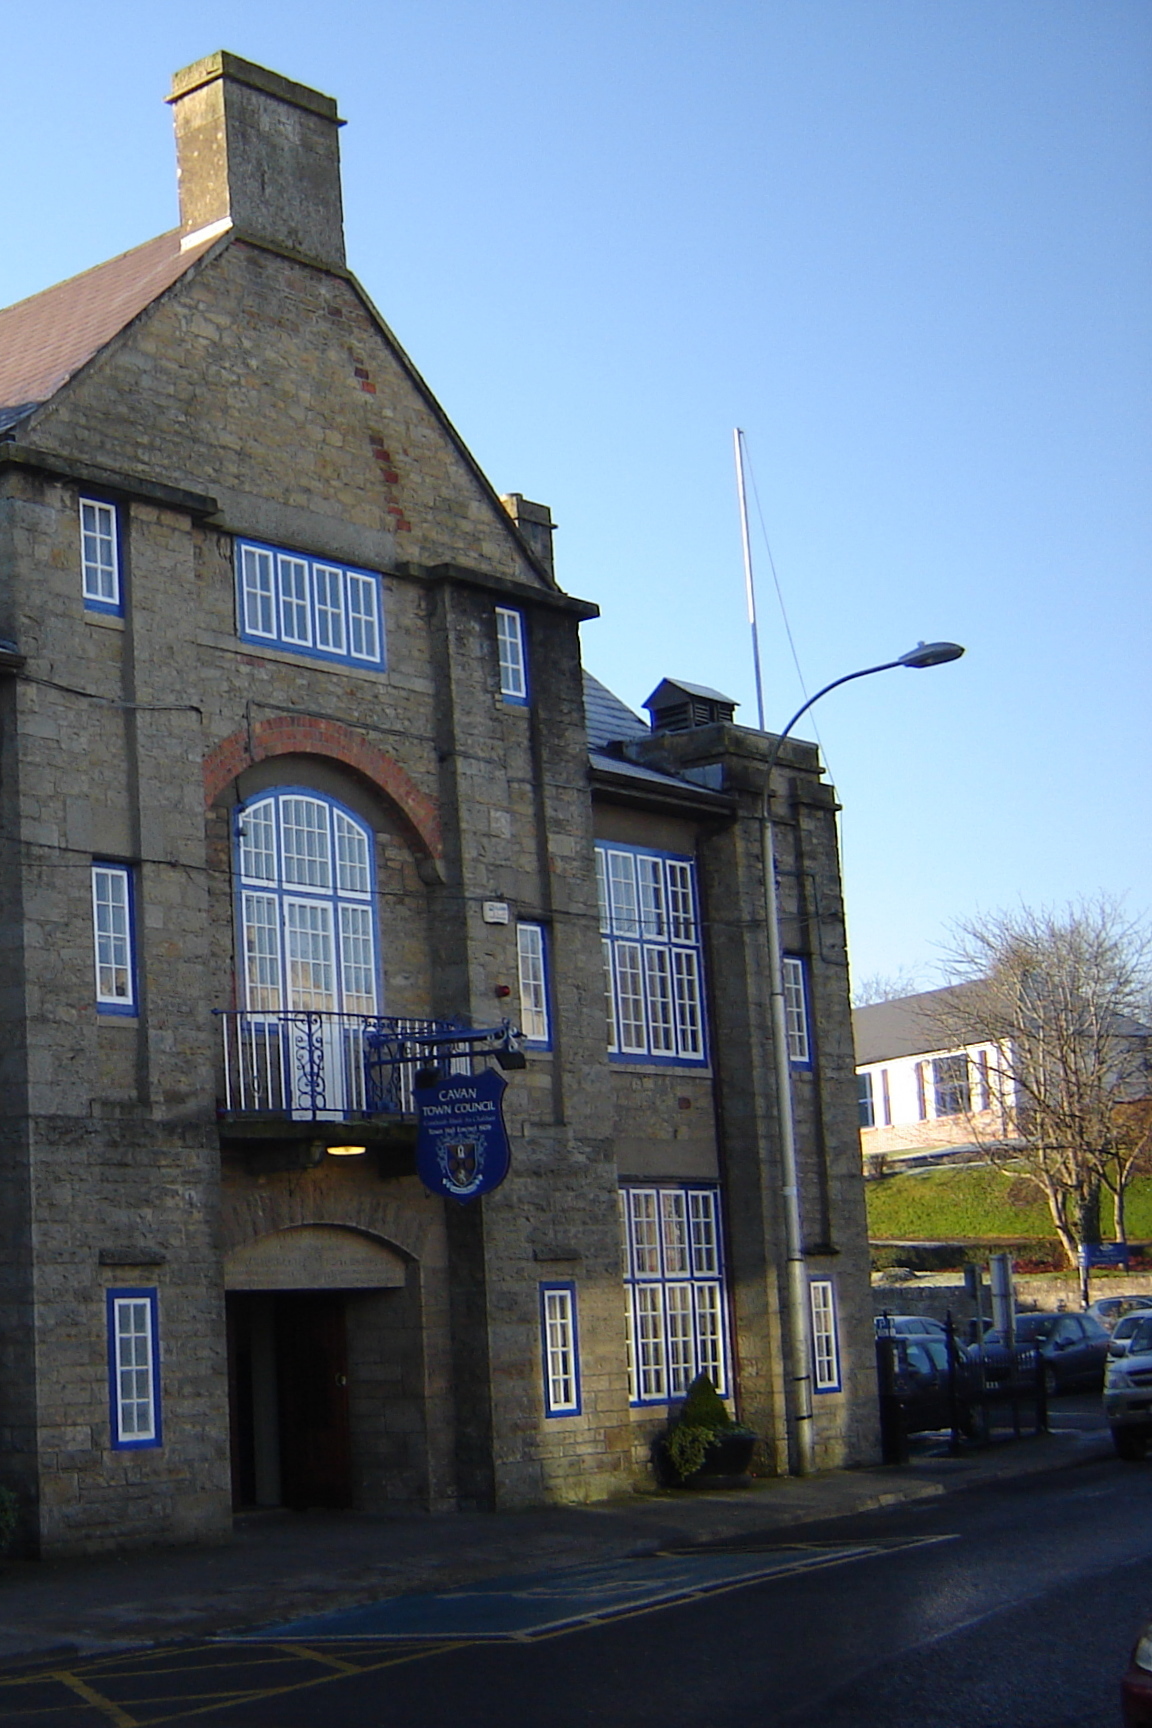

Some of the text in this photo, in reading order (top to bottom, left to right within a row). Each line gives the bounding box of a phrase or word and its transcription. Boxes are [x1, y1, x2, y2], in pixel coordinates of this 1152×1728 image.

[438, 1087, 477, 1102] CAVAN
[422, 1100, 496, 1117] TOWN COUNCIL
